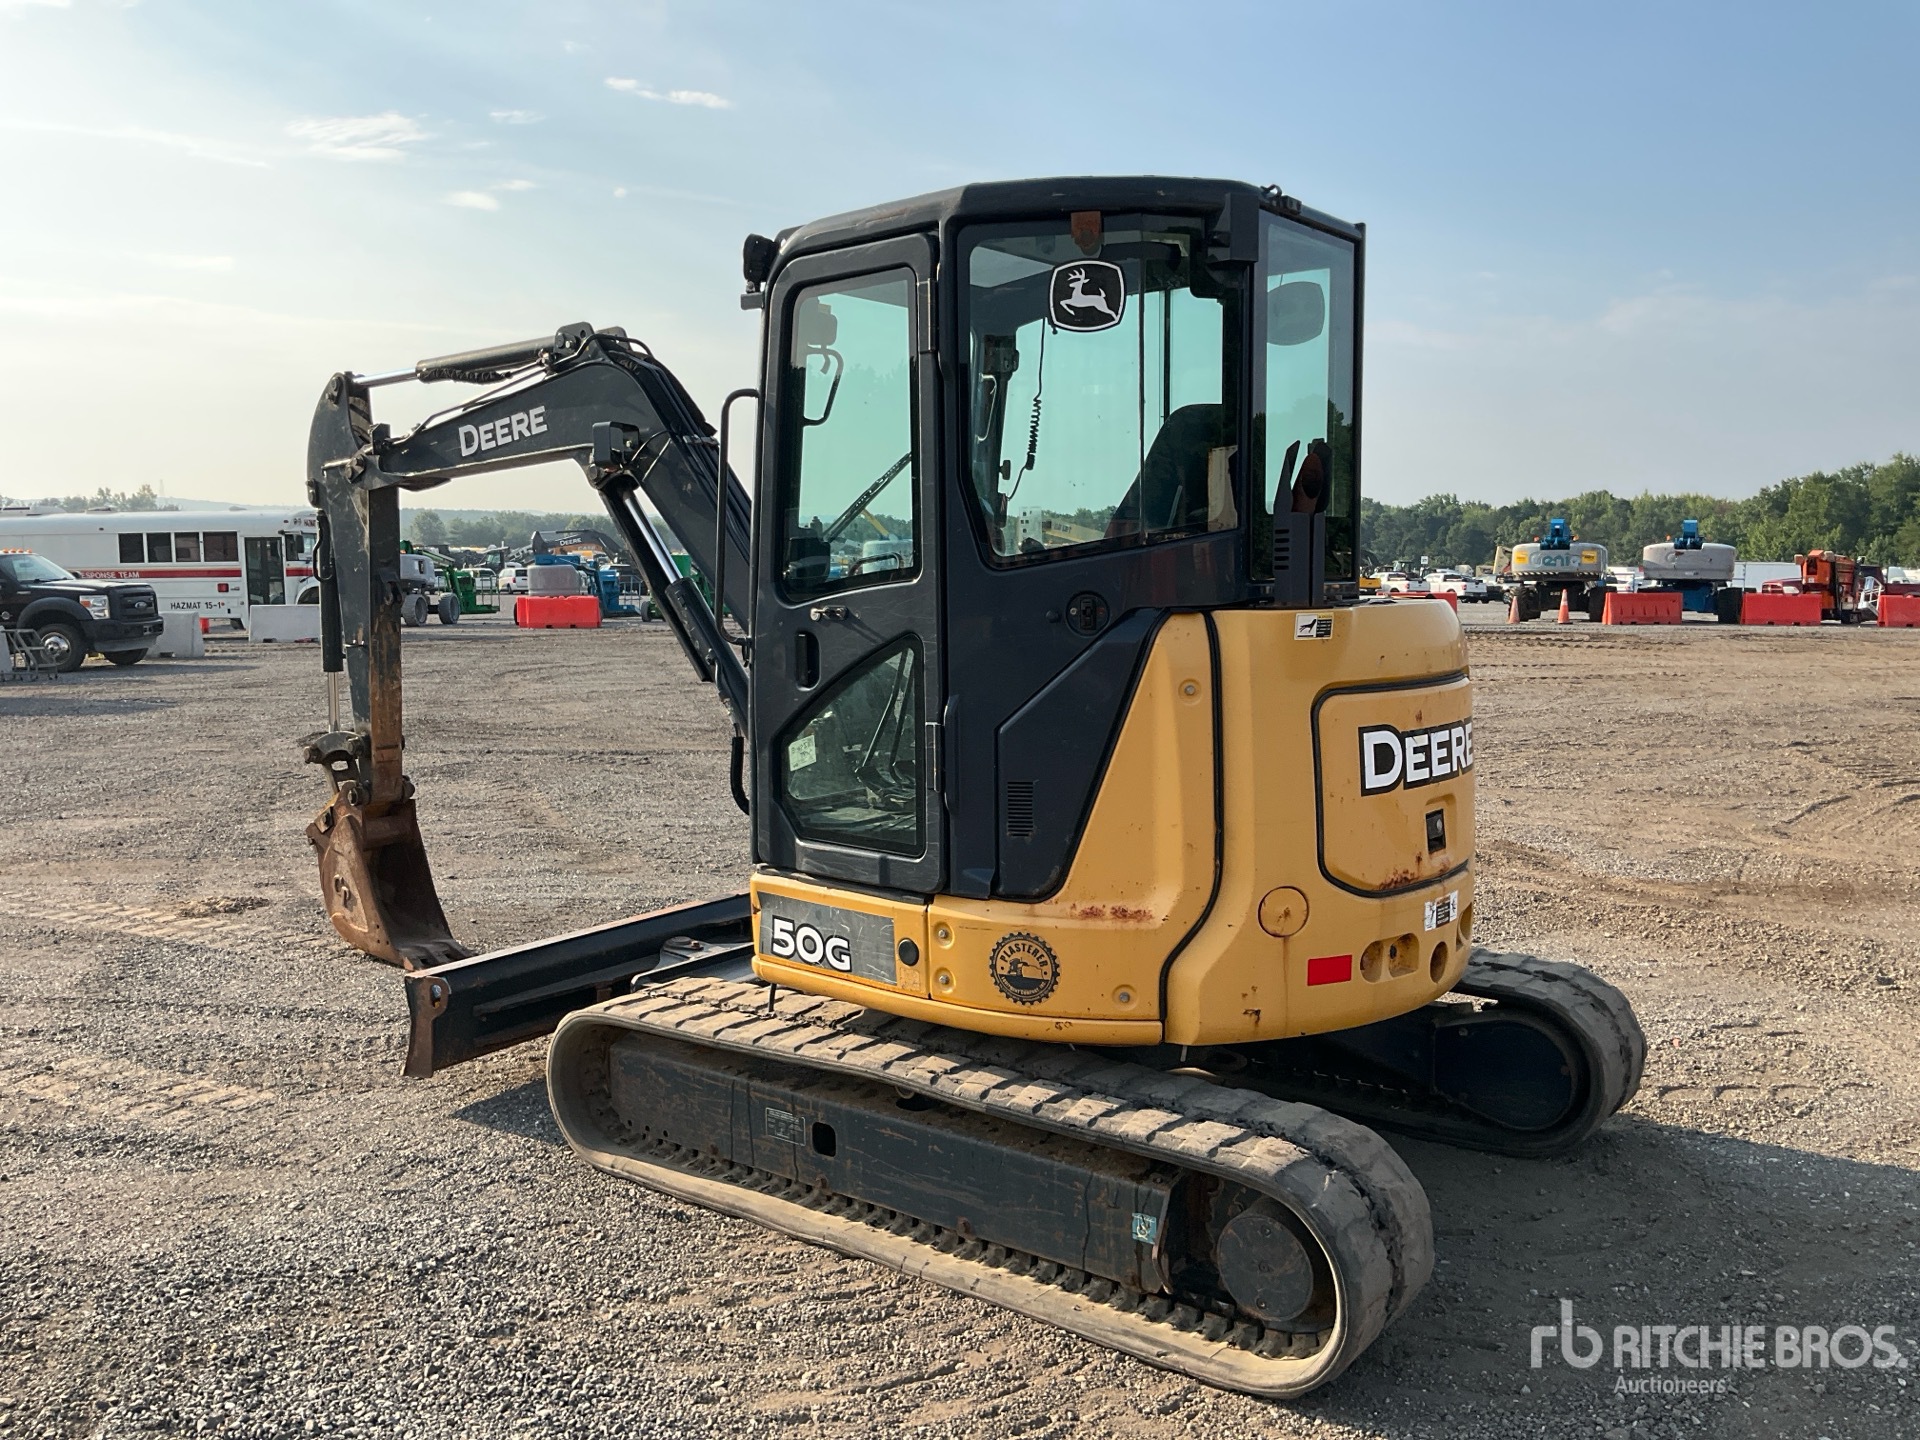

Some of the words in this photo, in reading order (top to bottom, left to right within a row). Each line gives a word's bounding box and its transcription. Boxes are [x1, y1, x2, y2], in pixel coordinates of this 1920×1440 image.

[458, 405, 548, 457] DEERE
[560, 538, 582, 546] DEERE
[80, 571, 117, 579] ESPONSE
[118, 571, 140, 579] TEAM
[170, 601, 201, 610] HAZMAT
[204, 601, 221, 610] 15-1
[1358, 716, 1474, 797] DEERE
[771, 914, 853, 973] 50G
[999, 942, 1049, 967] PLASTERER
